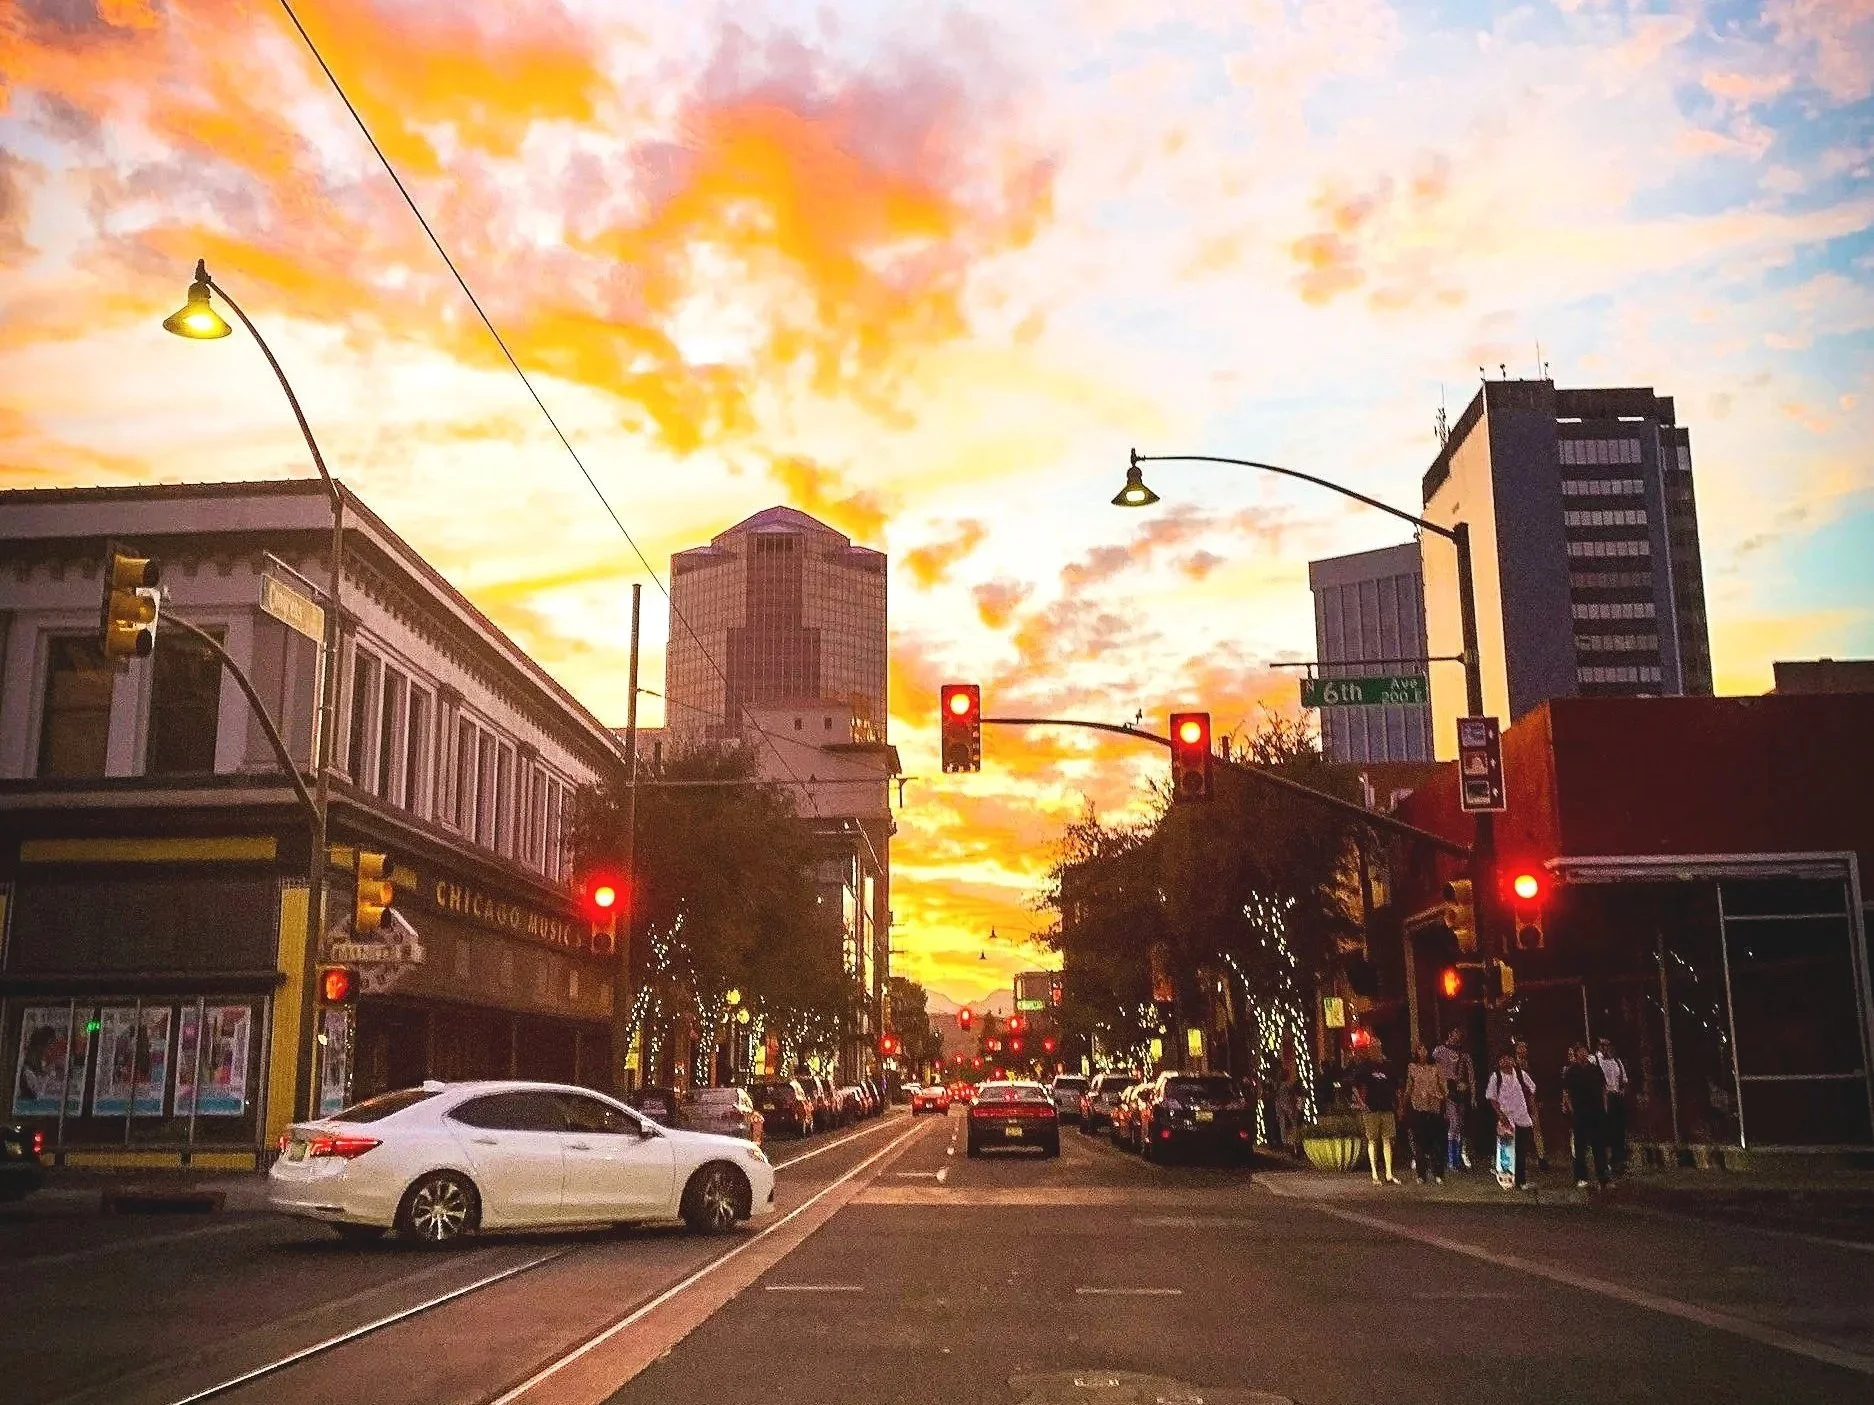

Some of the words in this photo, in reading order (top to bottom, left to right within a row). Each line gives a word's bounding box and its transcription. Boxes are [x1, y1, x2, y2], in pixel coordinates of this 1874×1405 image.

[1323, 681, 1363, 704] 6th
[1390, 678, 1418, 689] Ave
[436, 881, 520, 928] CHICAGO
[528, 913, 570, 947] MUSIC
